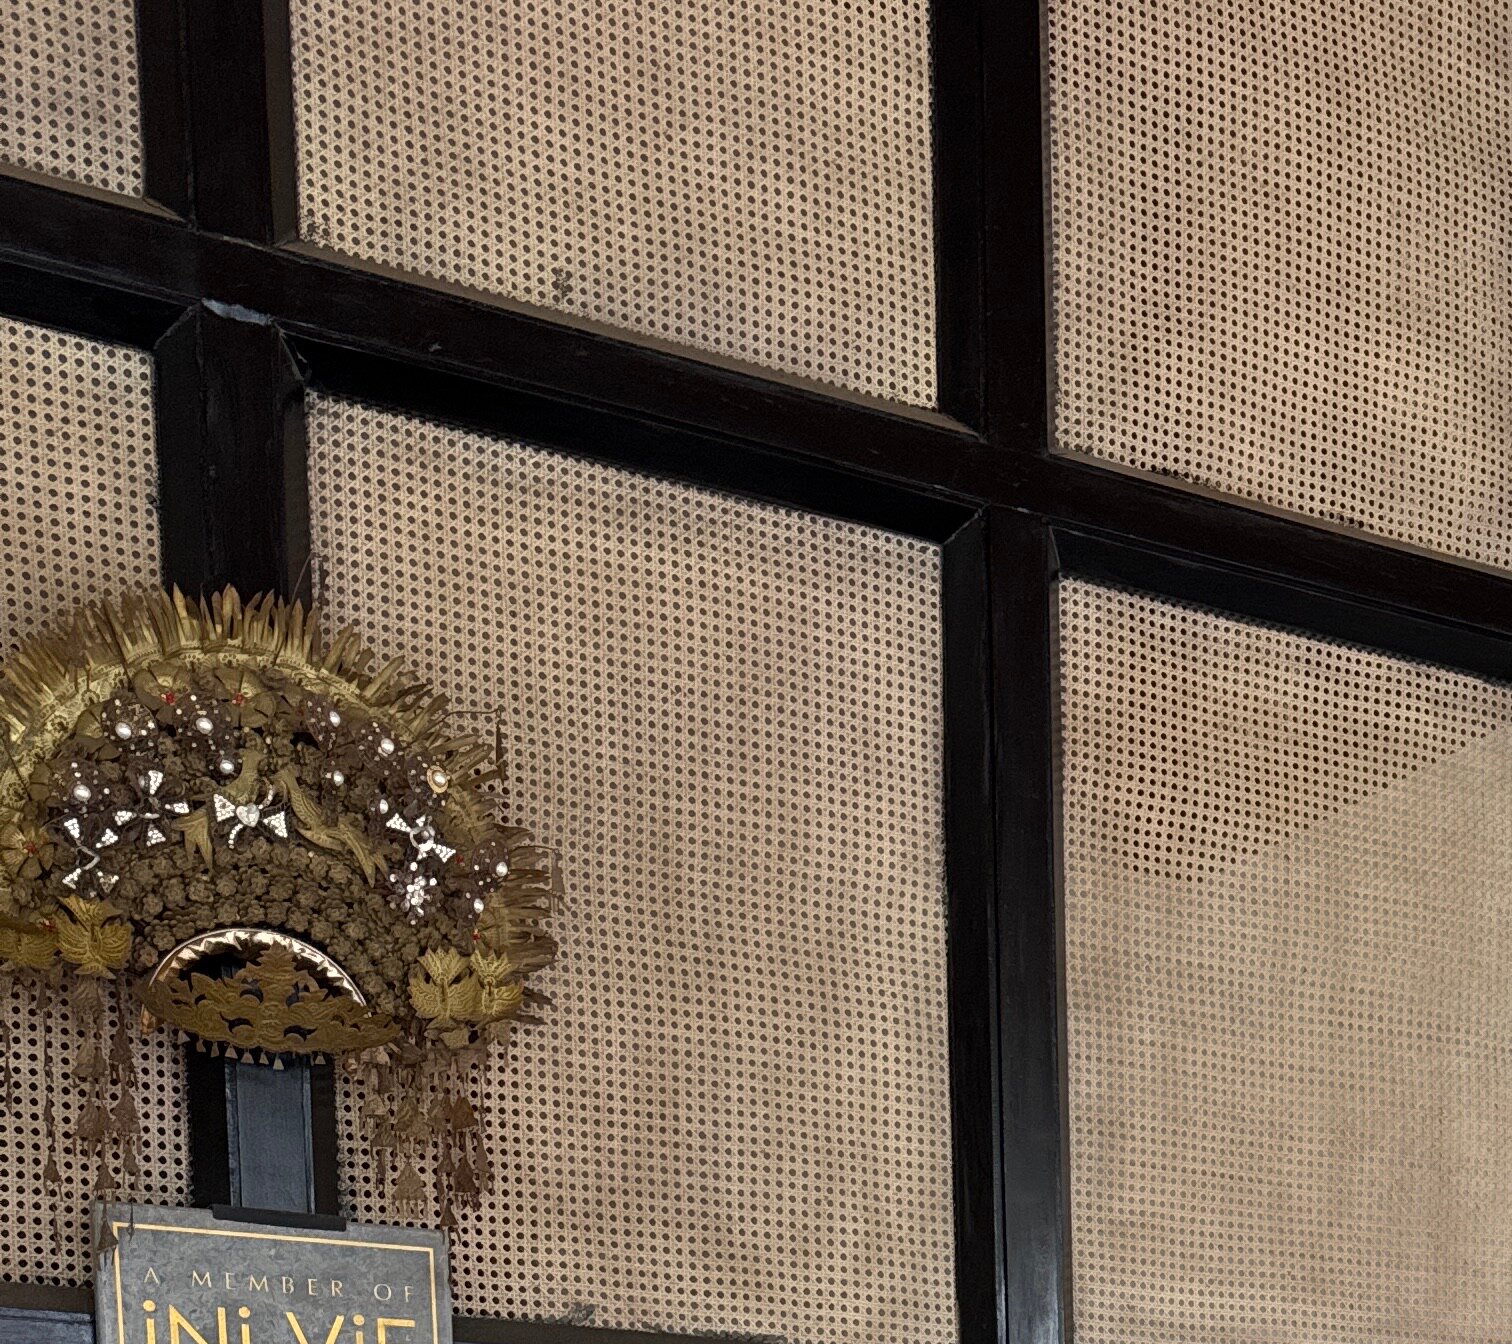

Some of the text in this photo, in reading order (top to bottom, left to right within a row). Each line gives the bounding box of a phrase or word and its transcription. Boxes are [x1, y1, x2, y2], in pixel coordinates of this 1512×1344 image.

[143, 1266, 415, 1303] A MEMBER OF
